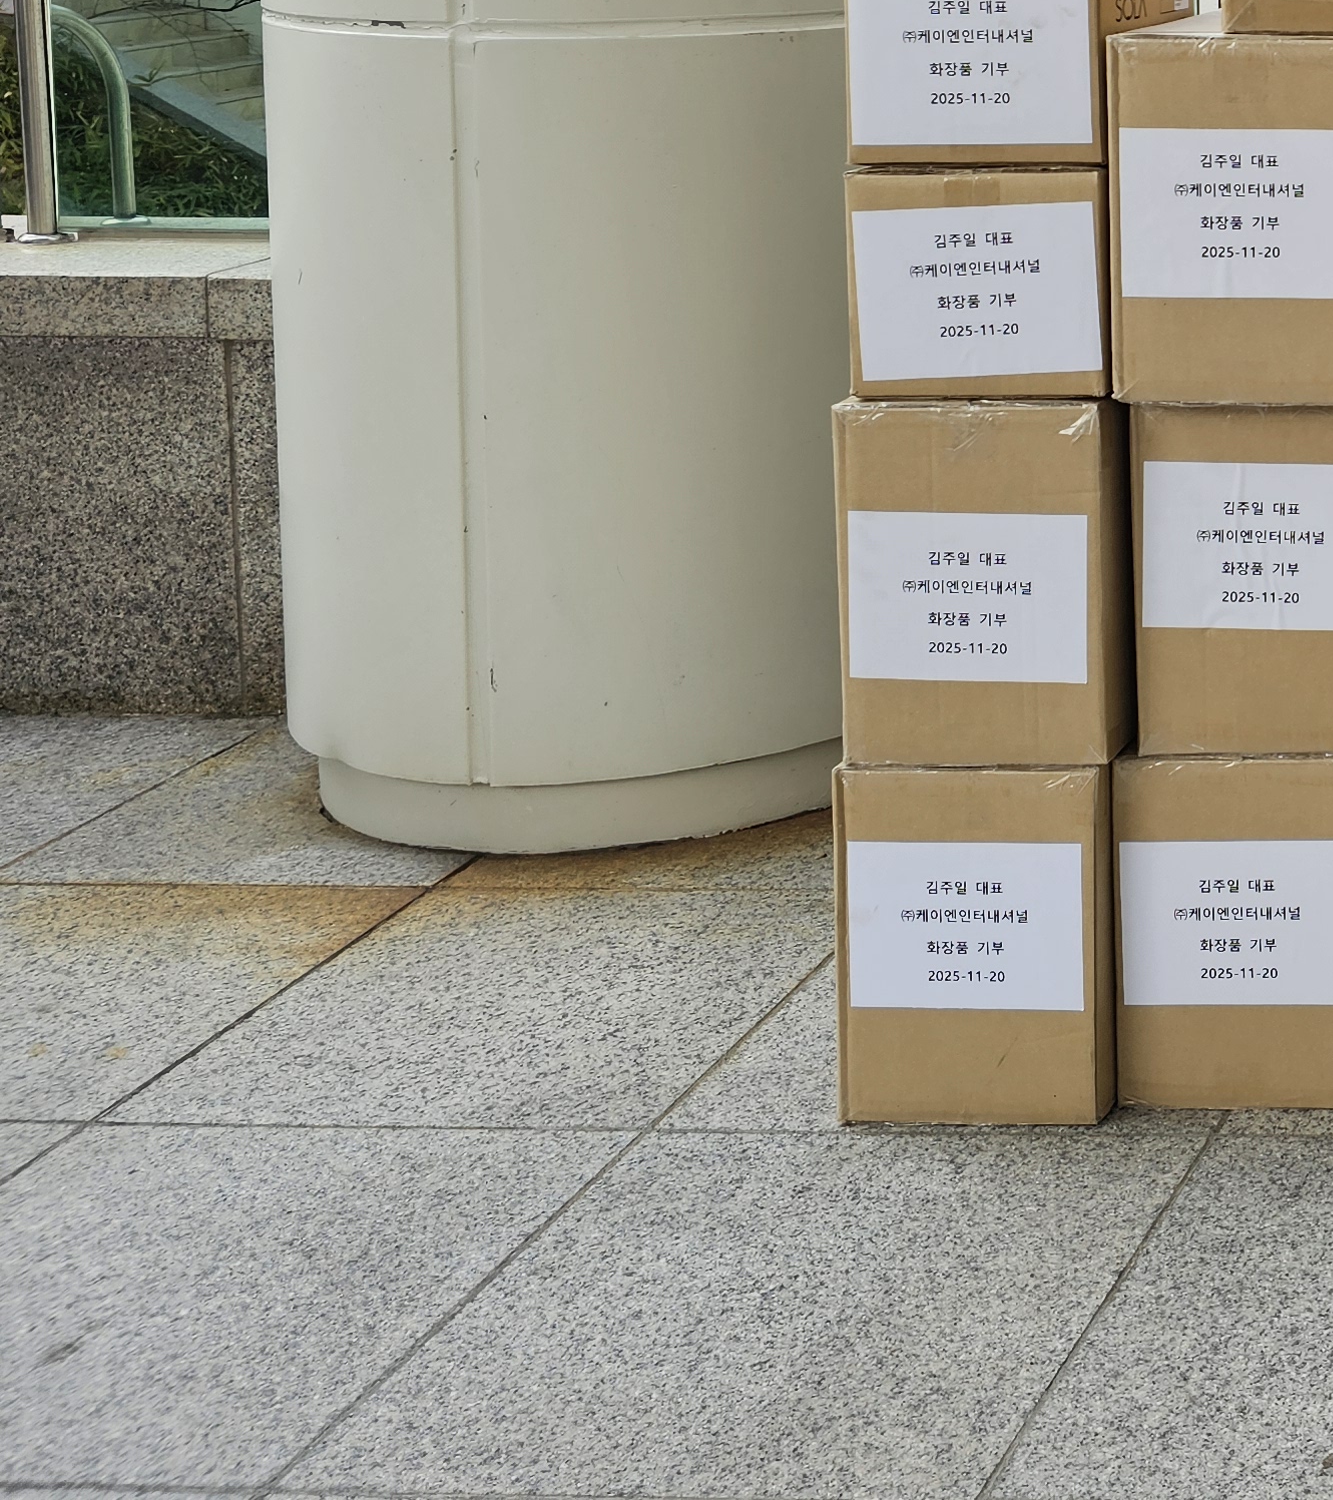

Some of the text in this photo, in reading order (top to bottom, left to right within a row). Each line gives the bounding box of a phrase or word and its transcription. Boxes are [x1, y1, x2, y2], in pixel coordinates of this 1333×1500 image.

[929, 0, 1007, 14] 김주일 대표
[929, 62, 1009, 76] 화장품 기부
[931, 93, 1010, 104] 2025-11-20
[935, 232, 1013, 249] 김주일 대표
[938, 293, 1016, 310] 화장품 기부
[940, 323, 1018, 337] 2025-11-20
[929, 552, 1007, 566] 김주일 대표
[928, 612, 1007, 627] 화장품 기부
[929, 642, 1007, 654] 2025-11-20
